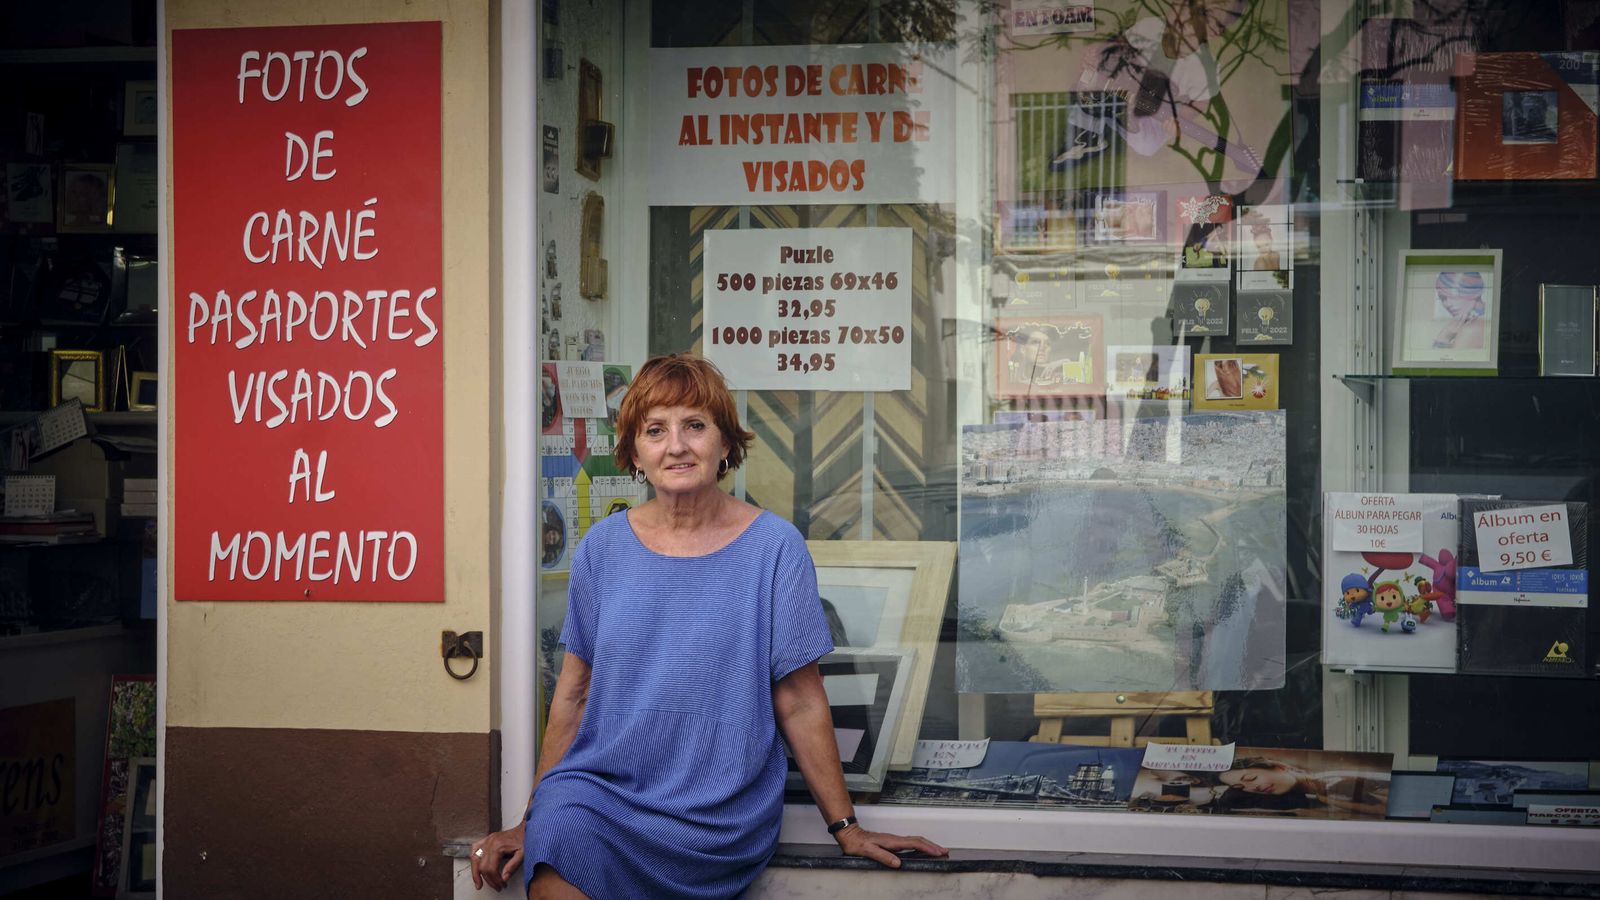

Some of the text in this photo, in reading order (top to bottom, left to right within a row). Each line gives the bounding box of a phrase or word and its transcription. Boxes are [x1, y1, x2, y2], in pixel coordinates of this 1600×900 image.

[237, 47, 369, 107] FOTOS
[687, 64, 778, 99] FOTOS
[785, 64, 822, 97] DE
[678, 110, 931, 146] AL INSTANTE Y DE
[285, 130, 337, 181] DE
[742, 159, 866, 192] VISADOS
[243, 197, 379, 270] CARNÉ
[780, 245, 834, 264] Puzle
[717, 272, 898, 295] 500 piezas 69x46
[188, 287, 438, 349] PASAPORTES
[778, 299, 837, 320] 32,95
[712, 325, 905, 348] 1000 piezas 70x50
[777, 353, 836, 374] 34,95
[228, 368, 398, 429] VISADOS
[289, 448, 335, 504] AL
[1361, 496, 1395, 506] OFERTA
[1366, 511, 1391, 520] PARA
[1392, 511, 1422, 520] PEGAR
[1477, 511, 1561, 529] Álbum en
[1357, 524, 1399, 534] 30 HOJAS
[1498, 531, 1549, 546] oferta
[1370, 539, 1386, 548] 10€
[208, 530, 418, 585] MOMENTO
[1500, 550, 1552, 566] 9,50 €
[1471, 577, 1497, 586] album
